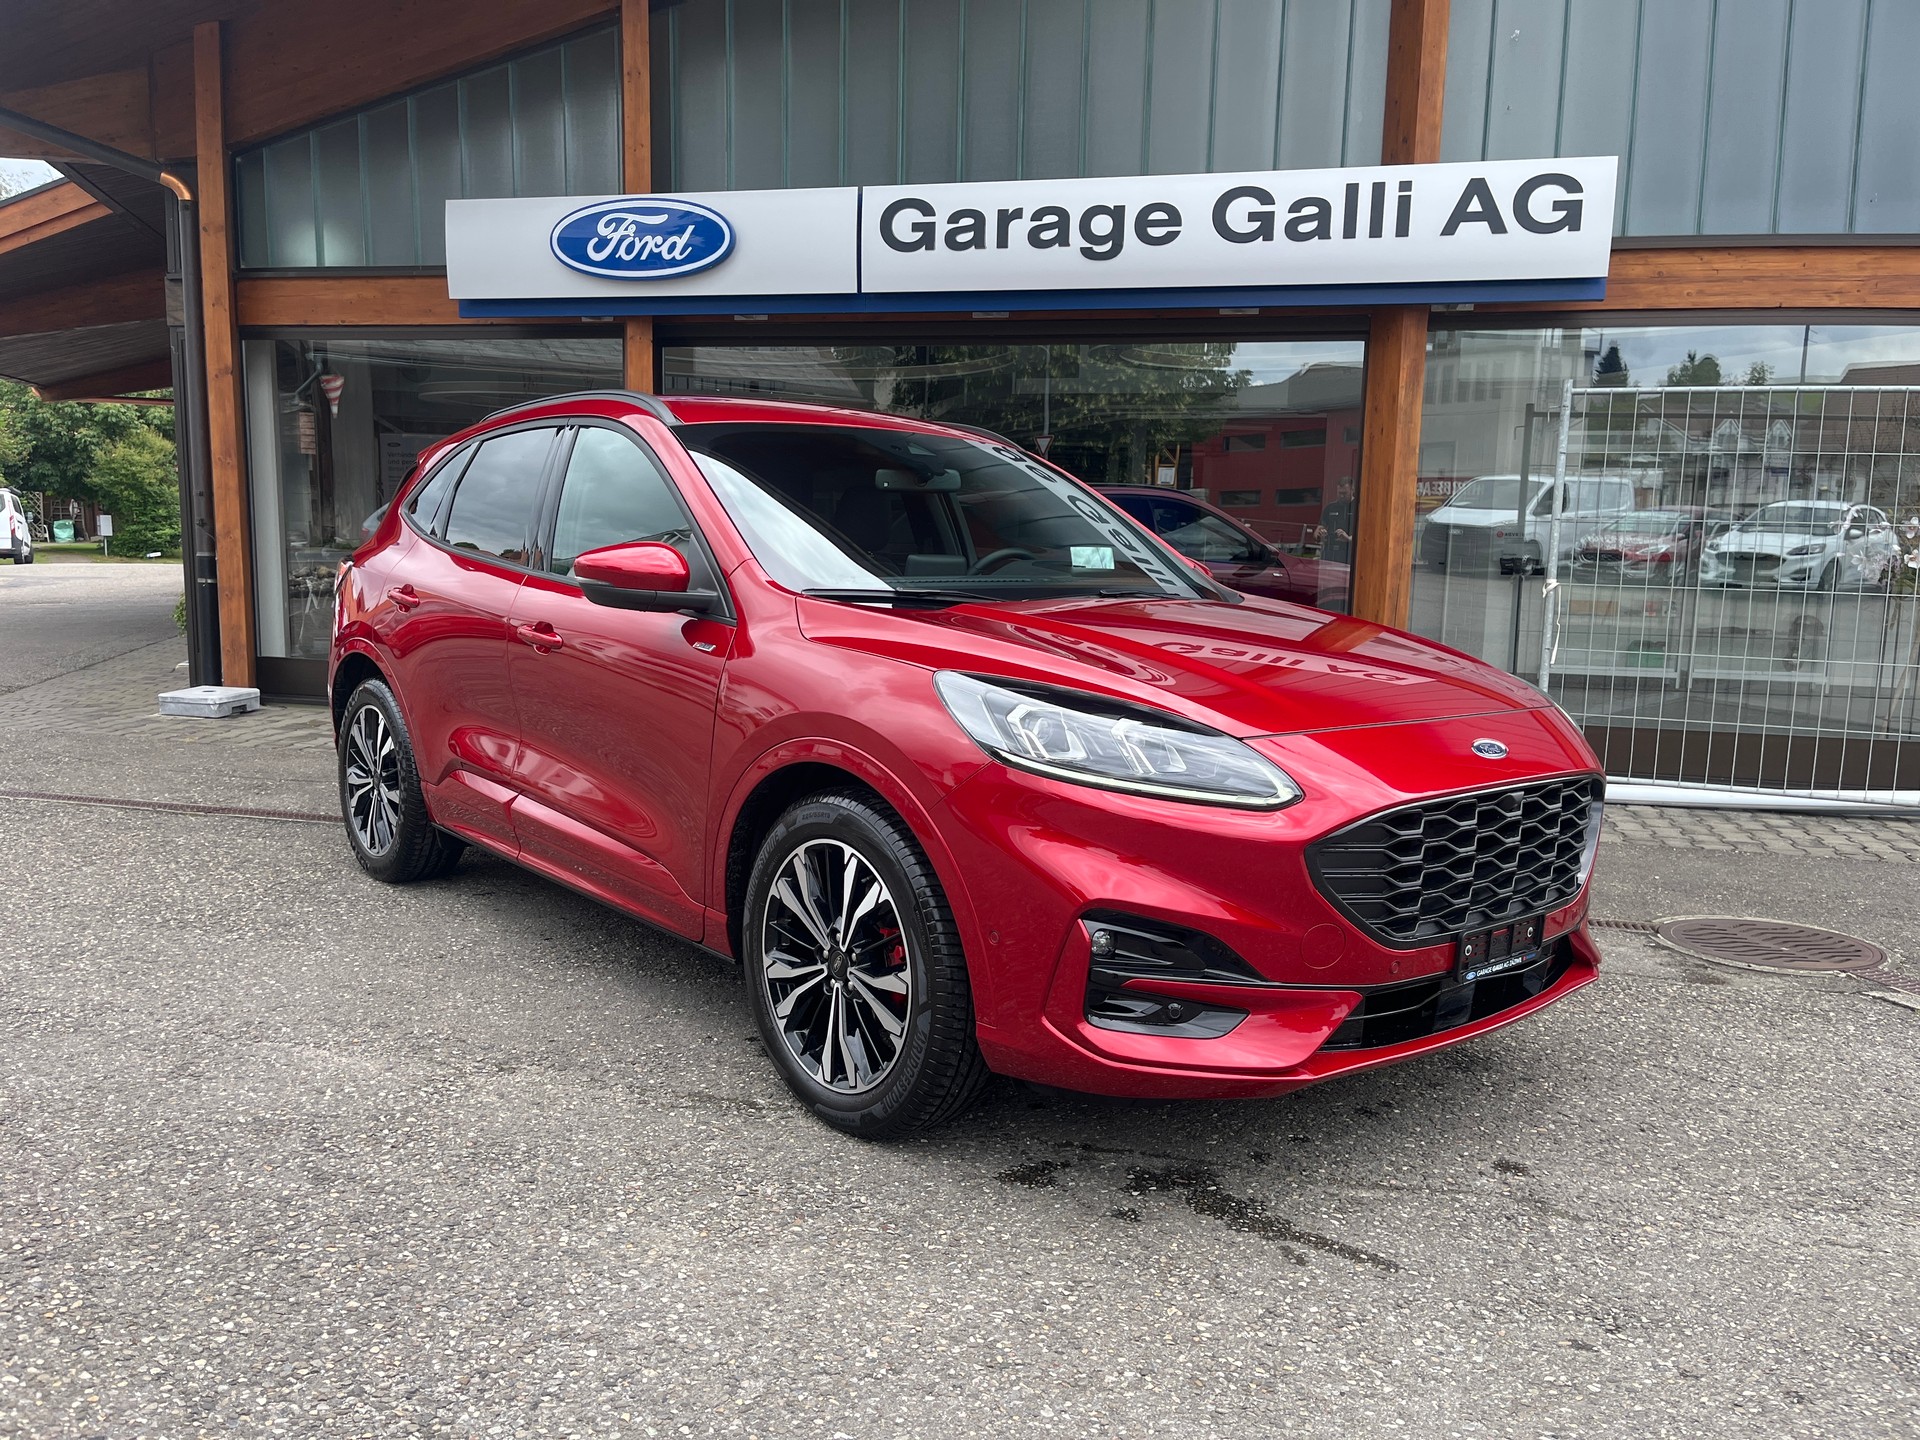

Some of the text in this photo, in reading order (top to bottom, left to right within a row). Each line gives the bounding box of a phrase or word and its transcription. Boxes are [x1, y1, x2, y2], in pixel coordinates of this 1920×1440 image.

[586, 212, 696, 262] Ford
[879, 173, 1584, 262] Garage Galli AG
[882, 1029, 928, 1113] BRIDGESTONE
